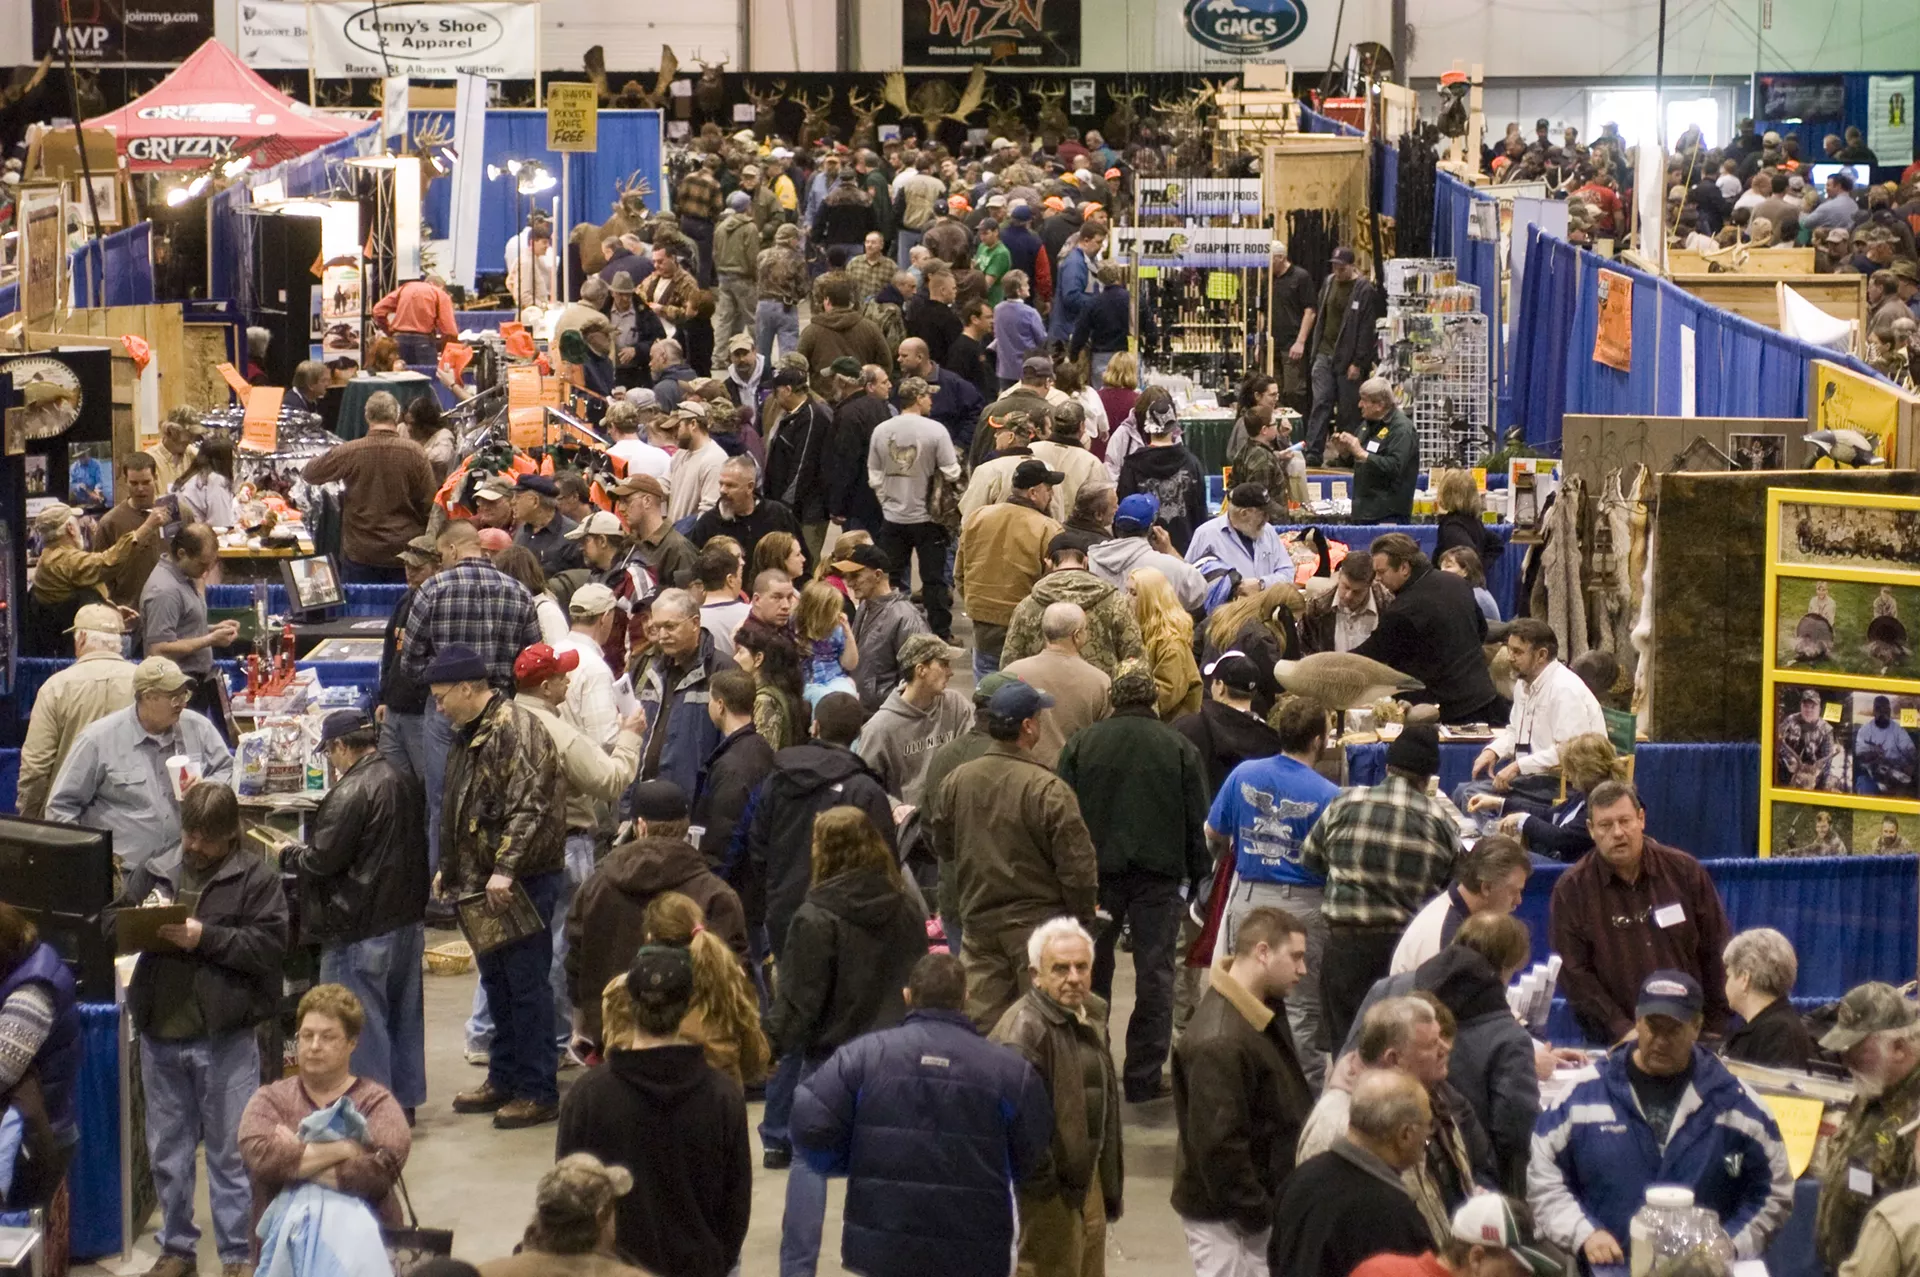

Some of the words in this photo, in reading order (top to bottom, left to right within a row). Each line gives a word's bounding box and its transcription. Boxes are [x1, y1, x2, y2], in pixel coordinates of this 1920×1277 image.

[124, 10, 199, 25] joinmvp.com
[359, 18, 429, 34] Lenny's
[439, 19, 487, 33] Shoe
[1214, 17, 1278, 36] GMCS
[52, 26, 109, 49] MVP
[402, 37, 472, 50] Apparel
[345, 64, 377, 73] Barre
[406, 64, 447, 74] Albans
[455, 65, 505, 74] Williston
[557, 119, 582, 129] KNIFE
[553, 128, 586, 144] FREE
[127, 136, 239, 164] GRIZZLY
[1196, 191, 1230, 201] TROPHY
[1233, 191, 1259, 201] RODS
[1194, 243, 1242, 254] GRAPHITE
[1244, 243, 1270, 254] RODS
